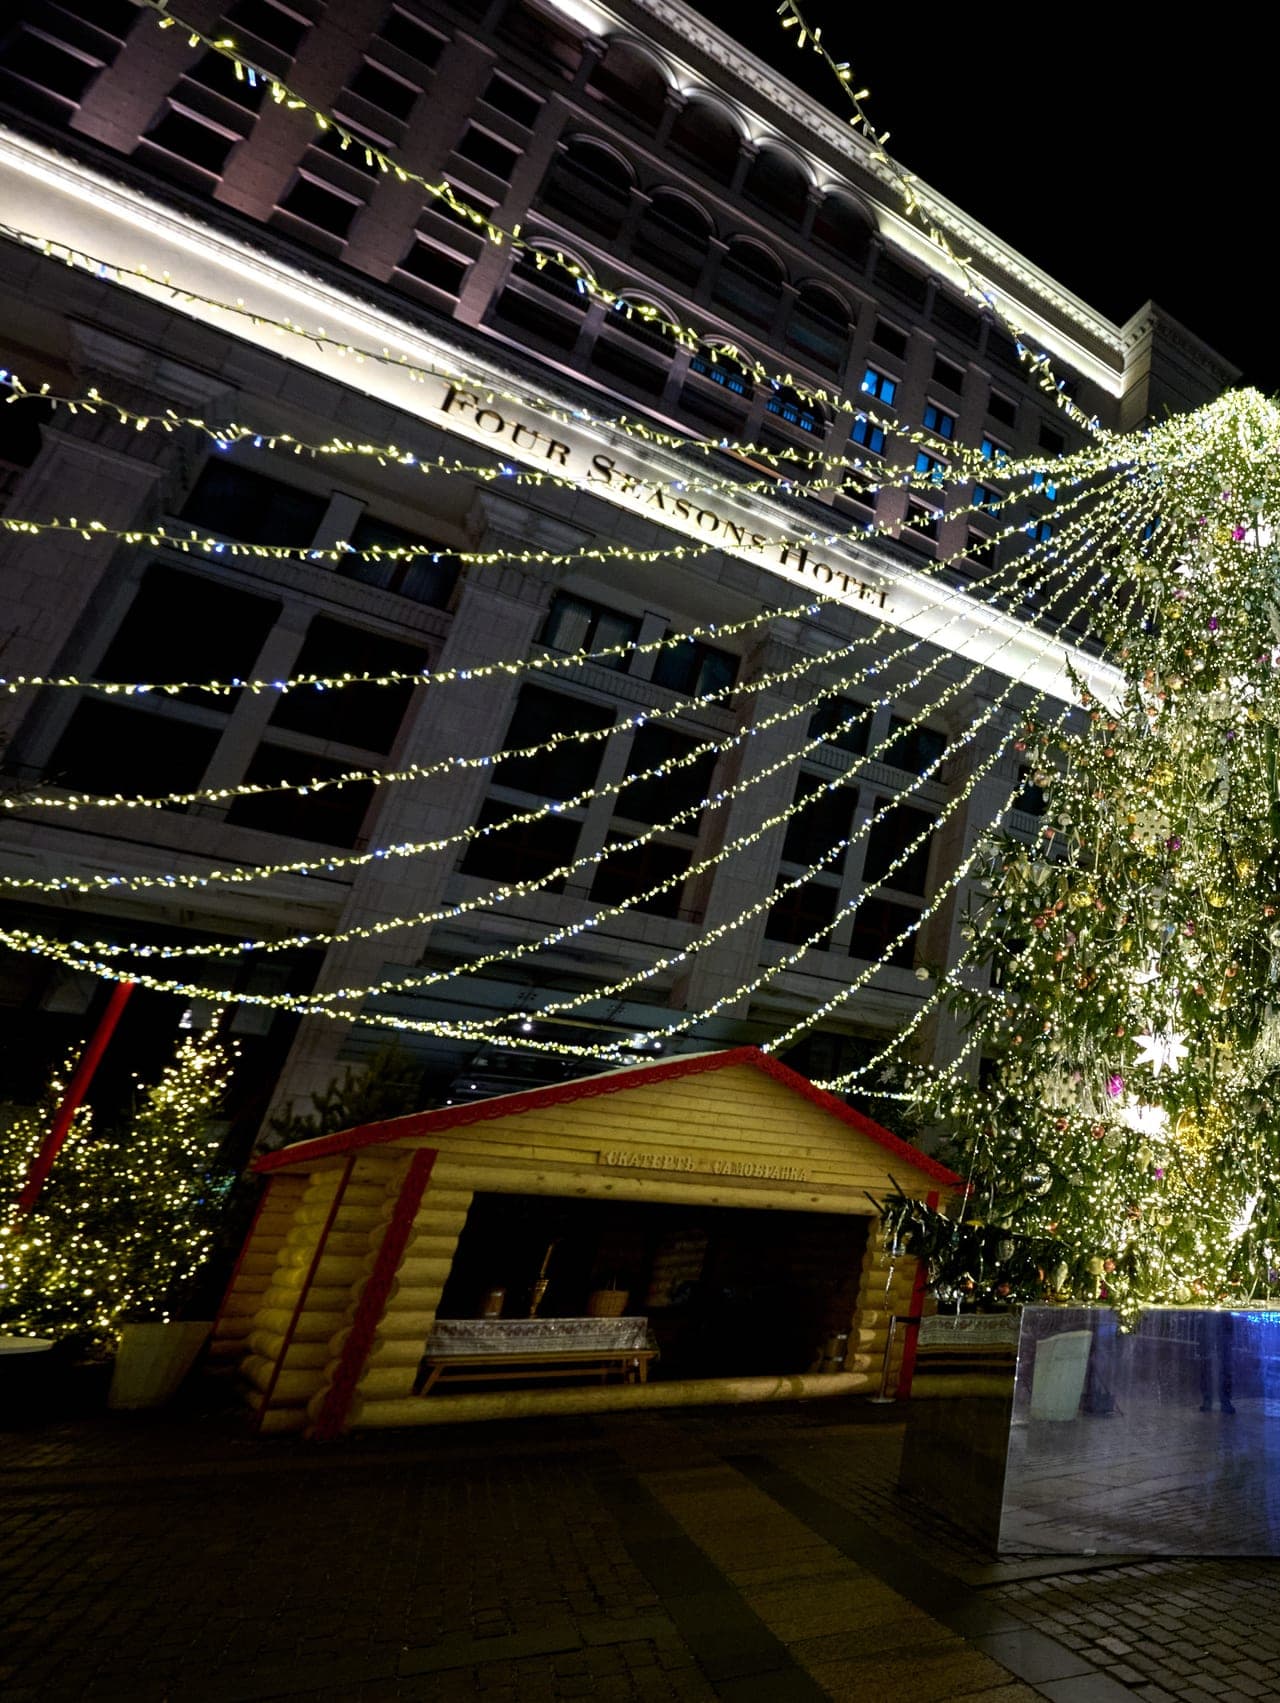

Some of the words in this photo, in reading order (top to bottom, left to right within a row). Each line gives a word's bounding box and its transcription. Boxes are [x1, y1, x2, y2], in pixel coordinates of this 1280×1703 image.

[440, 381, 571, 467] FOUR
[587, 454, 767, 554] SEASONS
[779, 542, 895, 613] HOTEL
[607, 1152, 694, 1171] СКАТЕРТЬ
